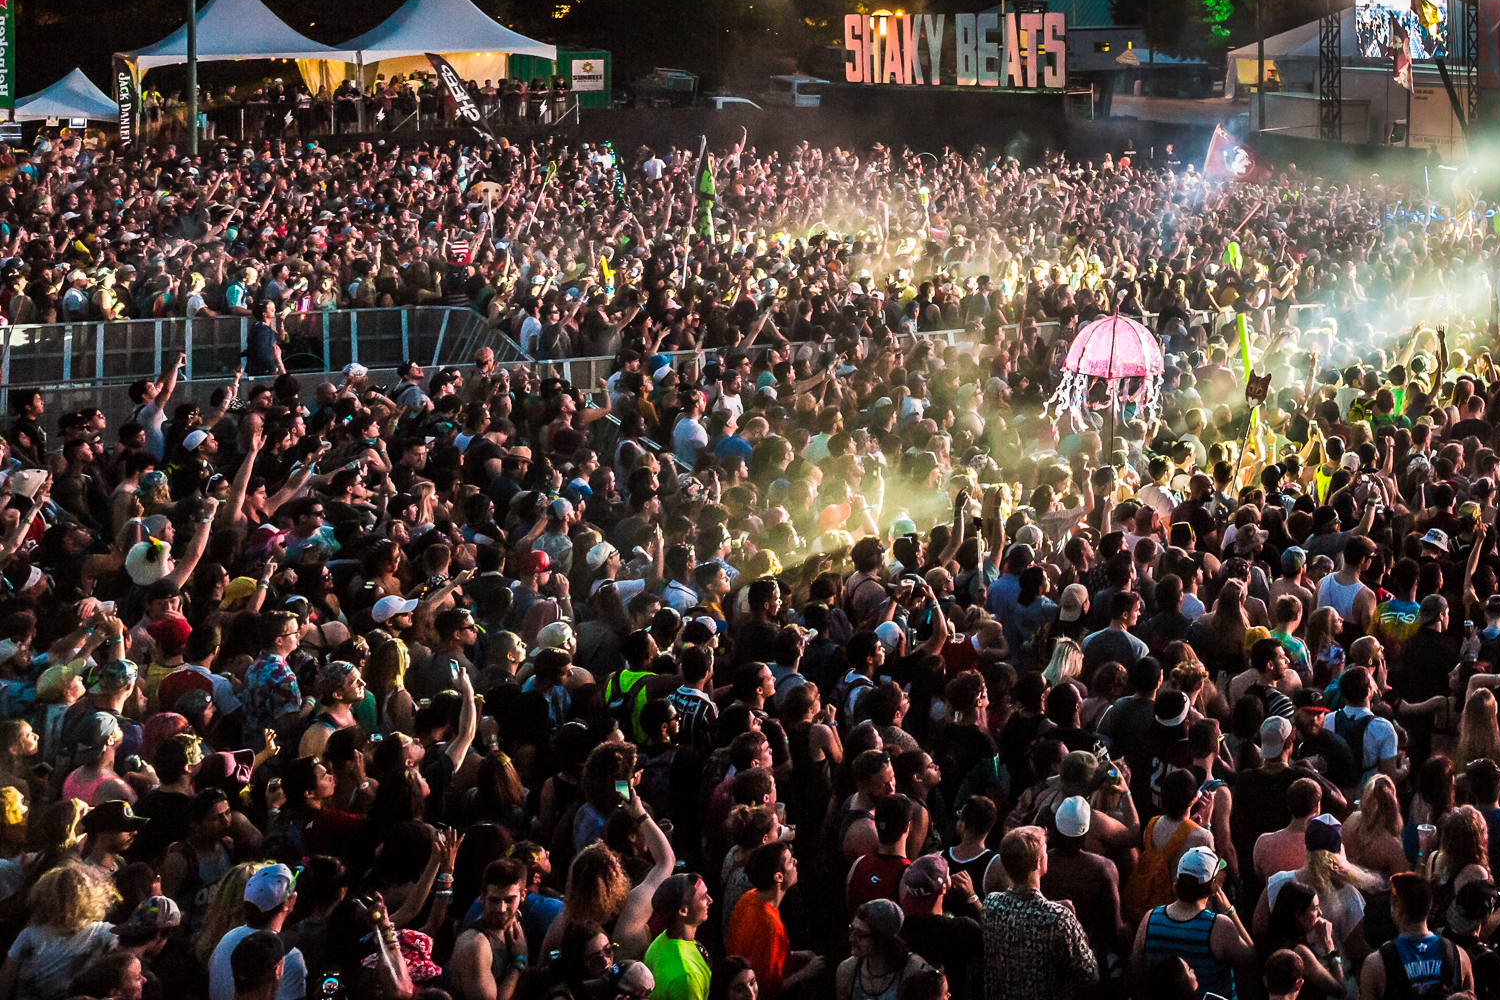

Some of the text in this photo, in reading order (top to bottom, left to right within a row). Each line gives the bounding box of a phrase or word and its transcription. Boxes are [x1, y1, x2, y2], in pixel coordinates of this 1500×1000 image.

[844, 11, 1066, 88] SHAKY BEATS
[119, 72, 131, 101] JACK
